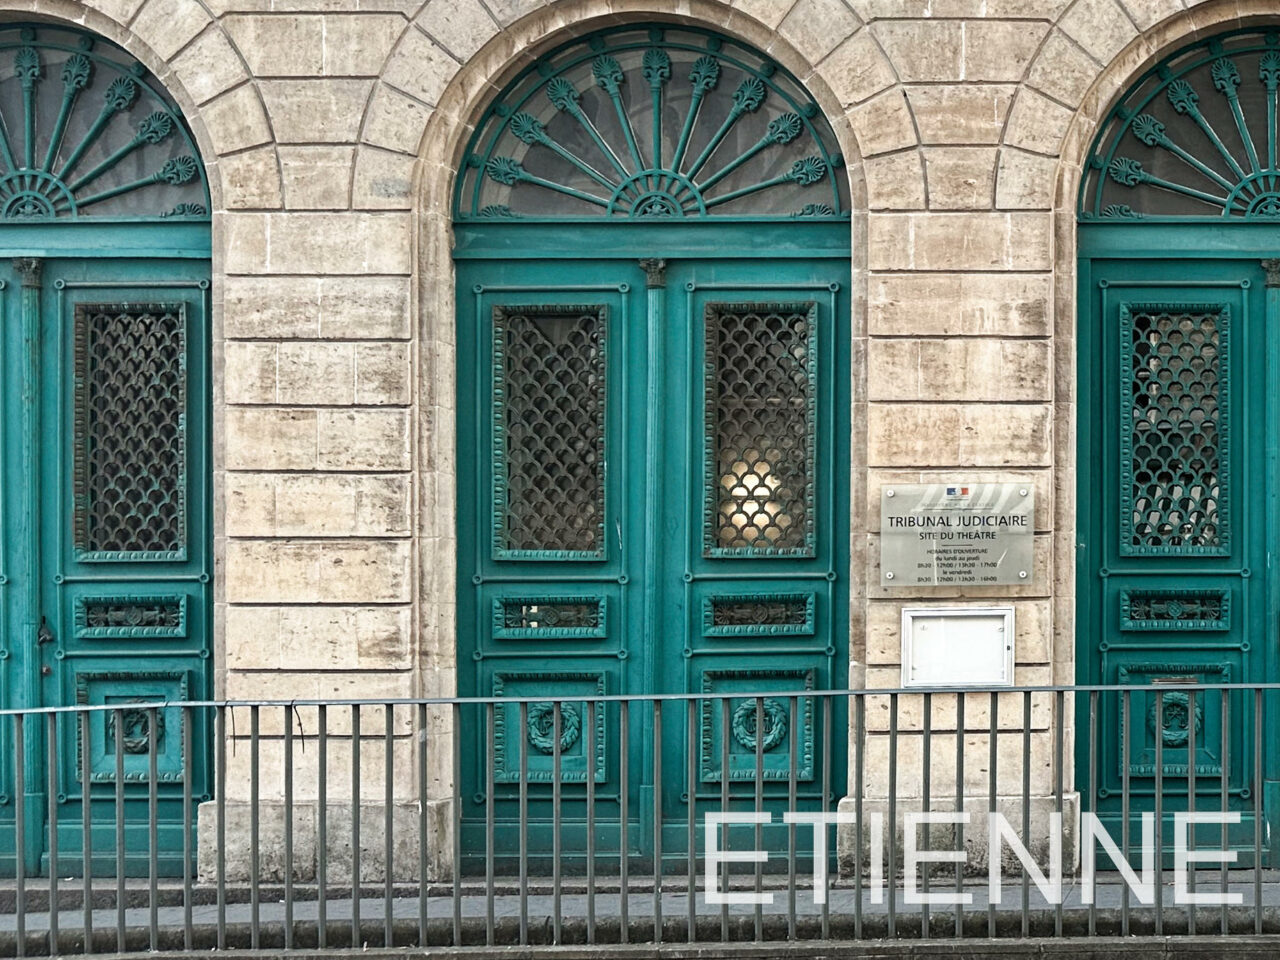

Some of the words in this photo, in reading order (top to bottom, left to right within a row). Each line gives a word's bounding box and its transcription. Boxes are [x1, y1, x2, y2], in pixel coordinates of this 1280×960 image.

[888, 516, 952, 528] TRIBUNAL
[956, 515, 1028, 527] JUDICIAIRE
[919, 531, 938, 540] SITE
[940, 531, 954, 540] DU
